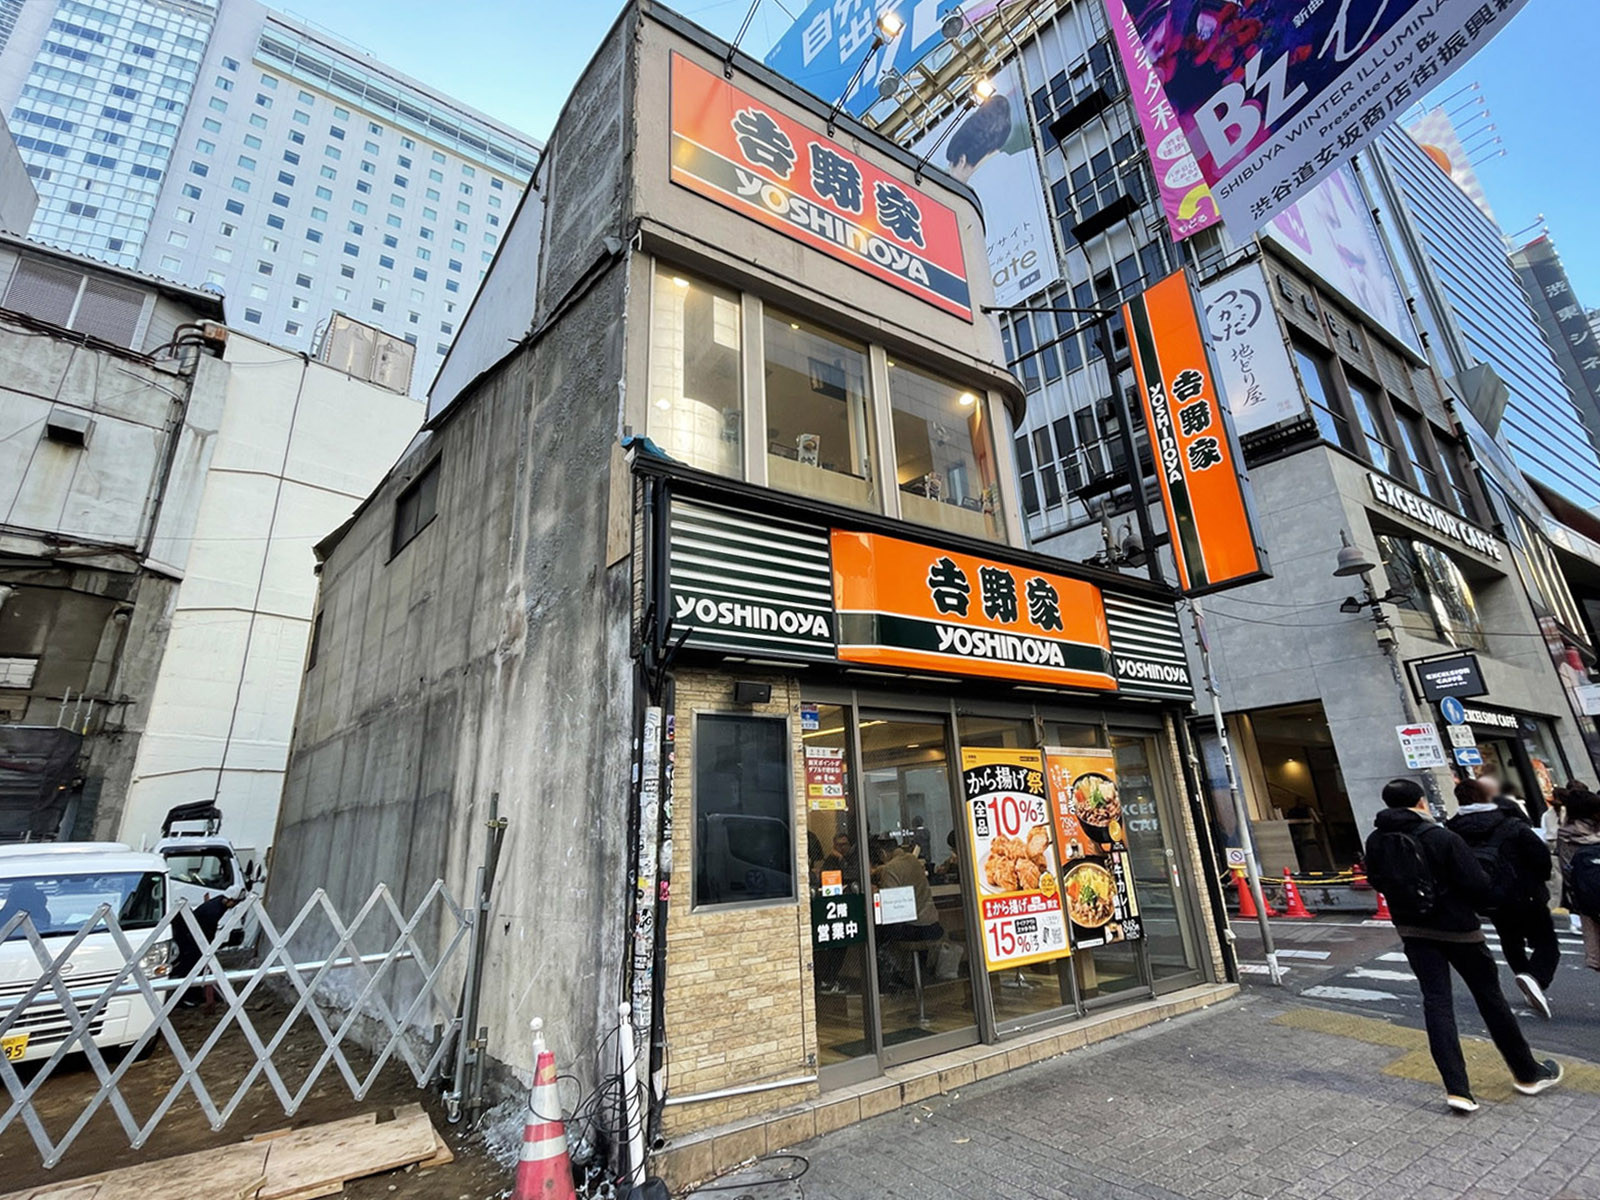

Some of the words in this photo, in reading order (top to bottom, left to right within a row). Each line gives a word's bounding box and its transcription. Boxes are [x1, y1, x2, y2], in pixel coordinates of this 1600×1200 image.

[1193, 48, 1309, 170] B'z
[1318, 73, 1391, 137] Presented
[1393, 55, 1414, 74] by
[1220, 143, 1286, 199] SHIBUYA
[1285, 81, 1354, 142] WINTER
[731, 106, 926, 250] 吉野家
[735, 169, 931, 286] YOSHINOYA
[1149, 382, 1182, 484] YOSHINOYA
[1172, 369, 1223, 471] 吉野家
[1369, 472, 1461, 540] EXCELSIOR
[927, 556, 1064, 633] 吉野家
[676, 595, 830, 638] YOSHINOYA
[936, 625, 1065, 667] YOSHINOYA
[1117, 658, 1188, 685] YOSHINOYA
[1425, 667, 1470, 680] EXCELSIOR
[967, 766, 1044, 794] から揚げ祭
[974, 801, 988, 834] 全品
[988, 796, 1038, 837] 10%
[817, 920, 859, 943] 営業中
[826, 901, 848, 919] 2階
[989, 921, 1031, 956] 15%
